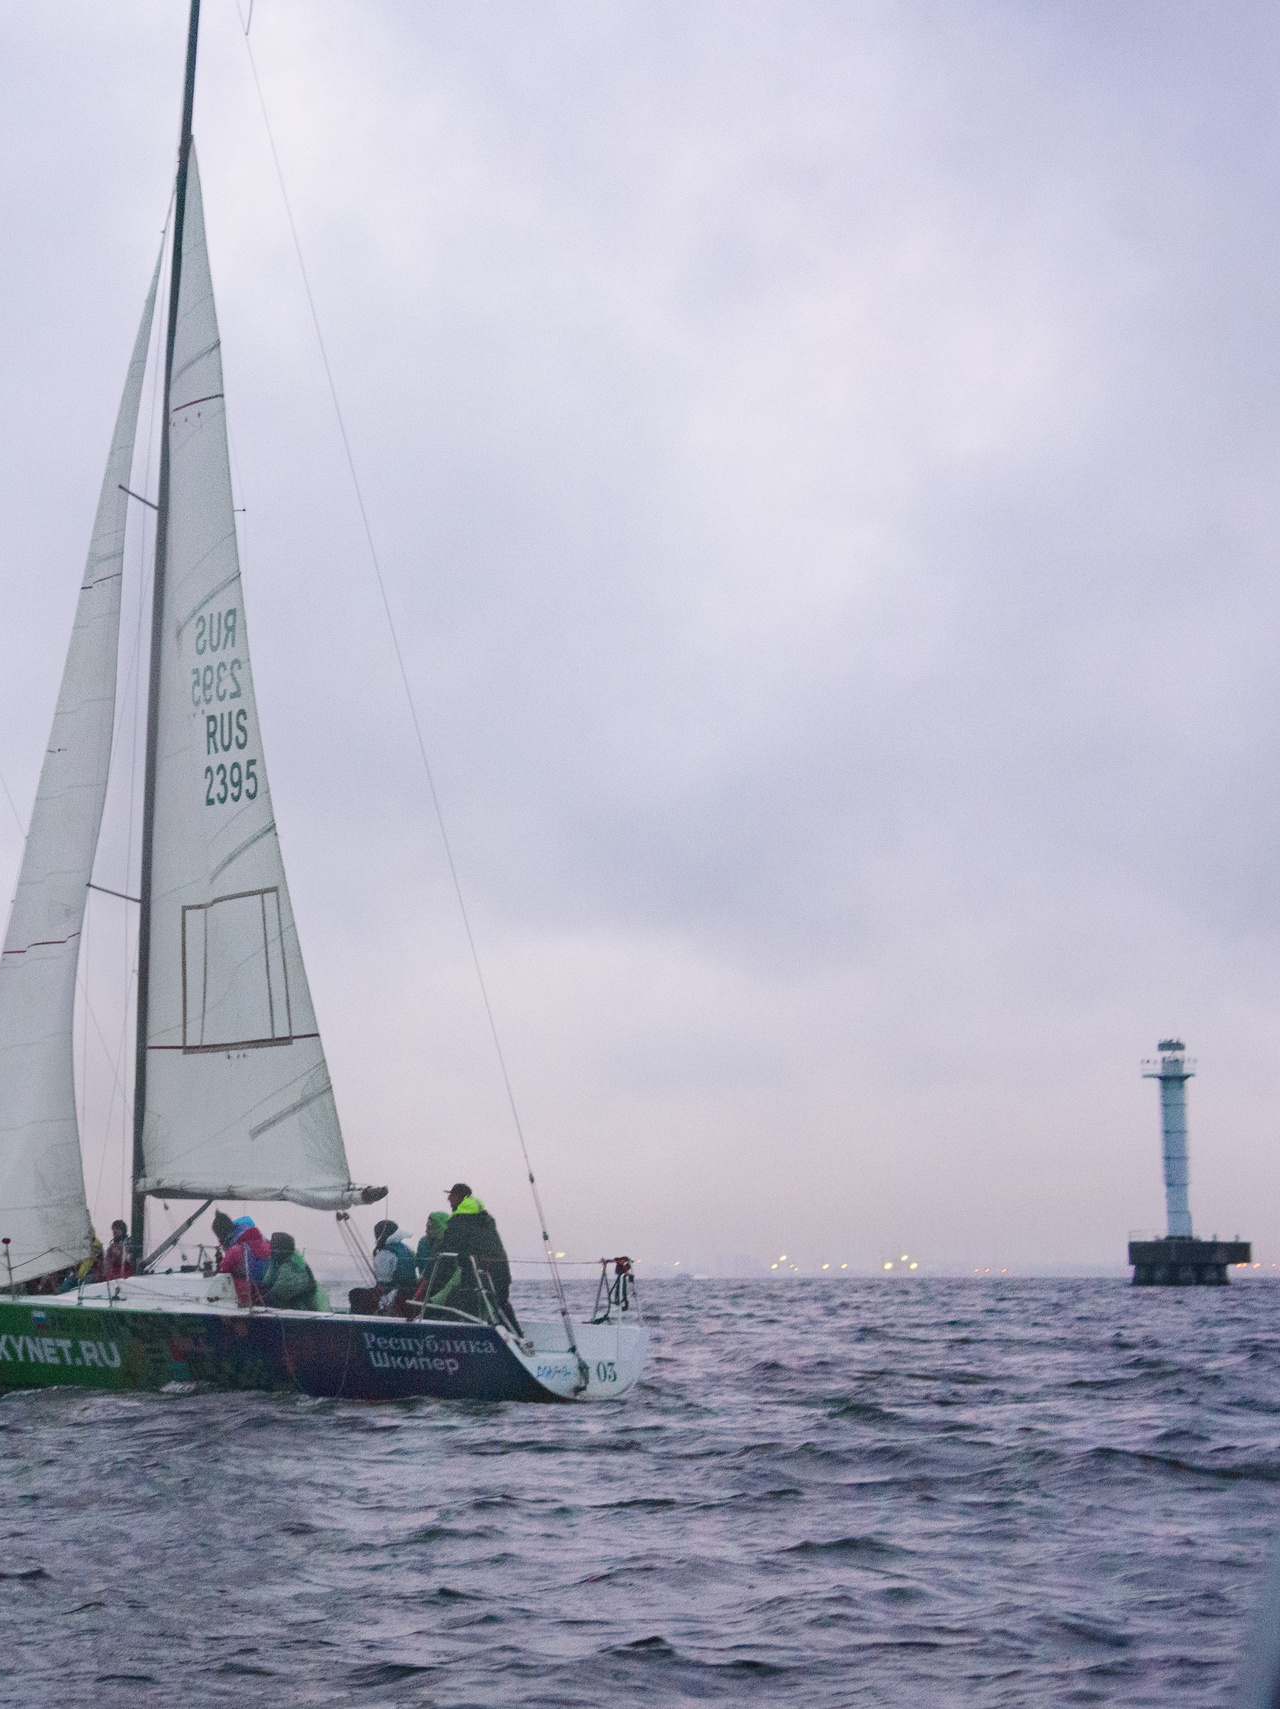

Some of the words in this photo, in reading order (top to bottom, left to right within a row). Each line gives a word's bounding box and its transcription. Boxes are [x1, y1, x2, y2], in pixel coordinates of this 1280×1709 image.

[206, 708, 248, 755] RUS
[204, 759, 258, 806] 2395
[363, 1331, 498, 1361] Республика
[370, 1351, 459, 1375] Шкипер
[596, 1361, 618, 1383] 03
